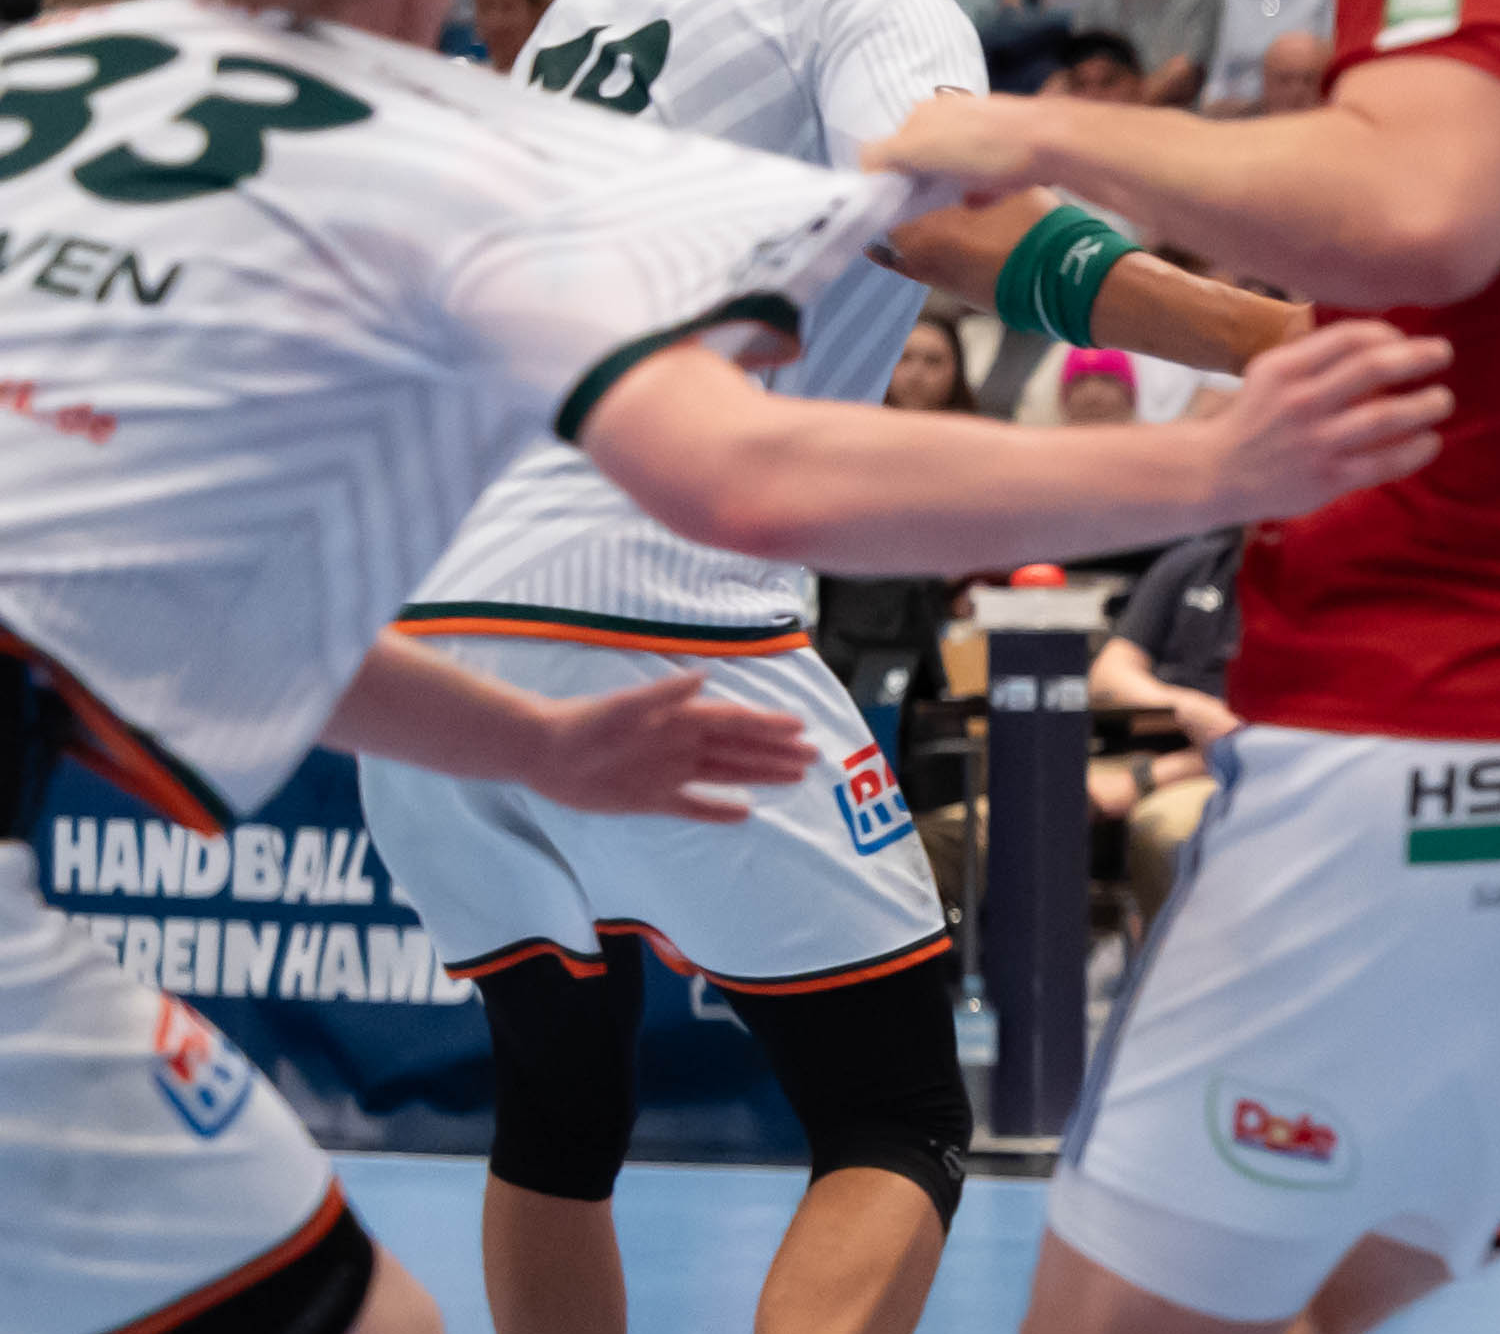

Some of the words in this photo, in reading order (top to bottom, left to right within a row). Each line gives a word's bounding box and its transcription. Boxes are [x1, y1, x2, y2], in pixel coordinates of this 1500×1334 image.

[52, 816, 375, 907] HANDBALL
[68, 913, 281, 999] EREIN
[1231, 1097, 1338, 1161] Dole
